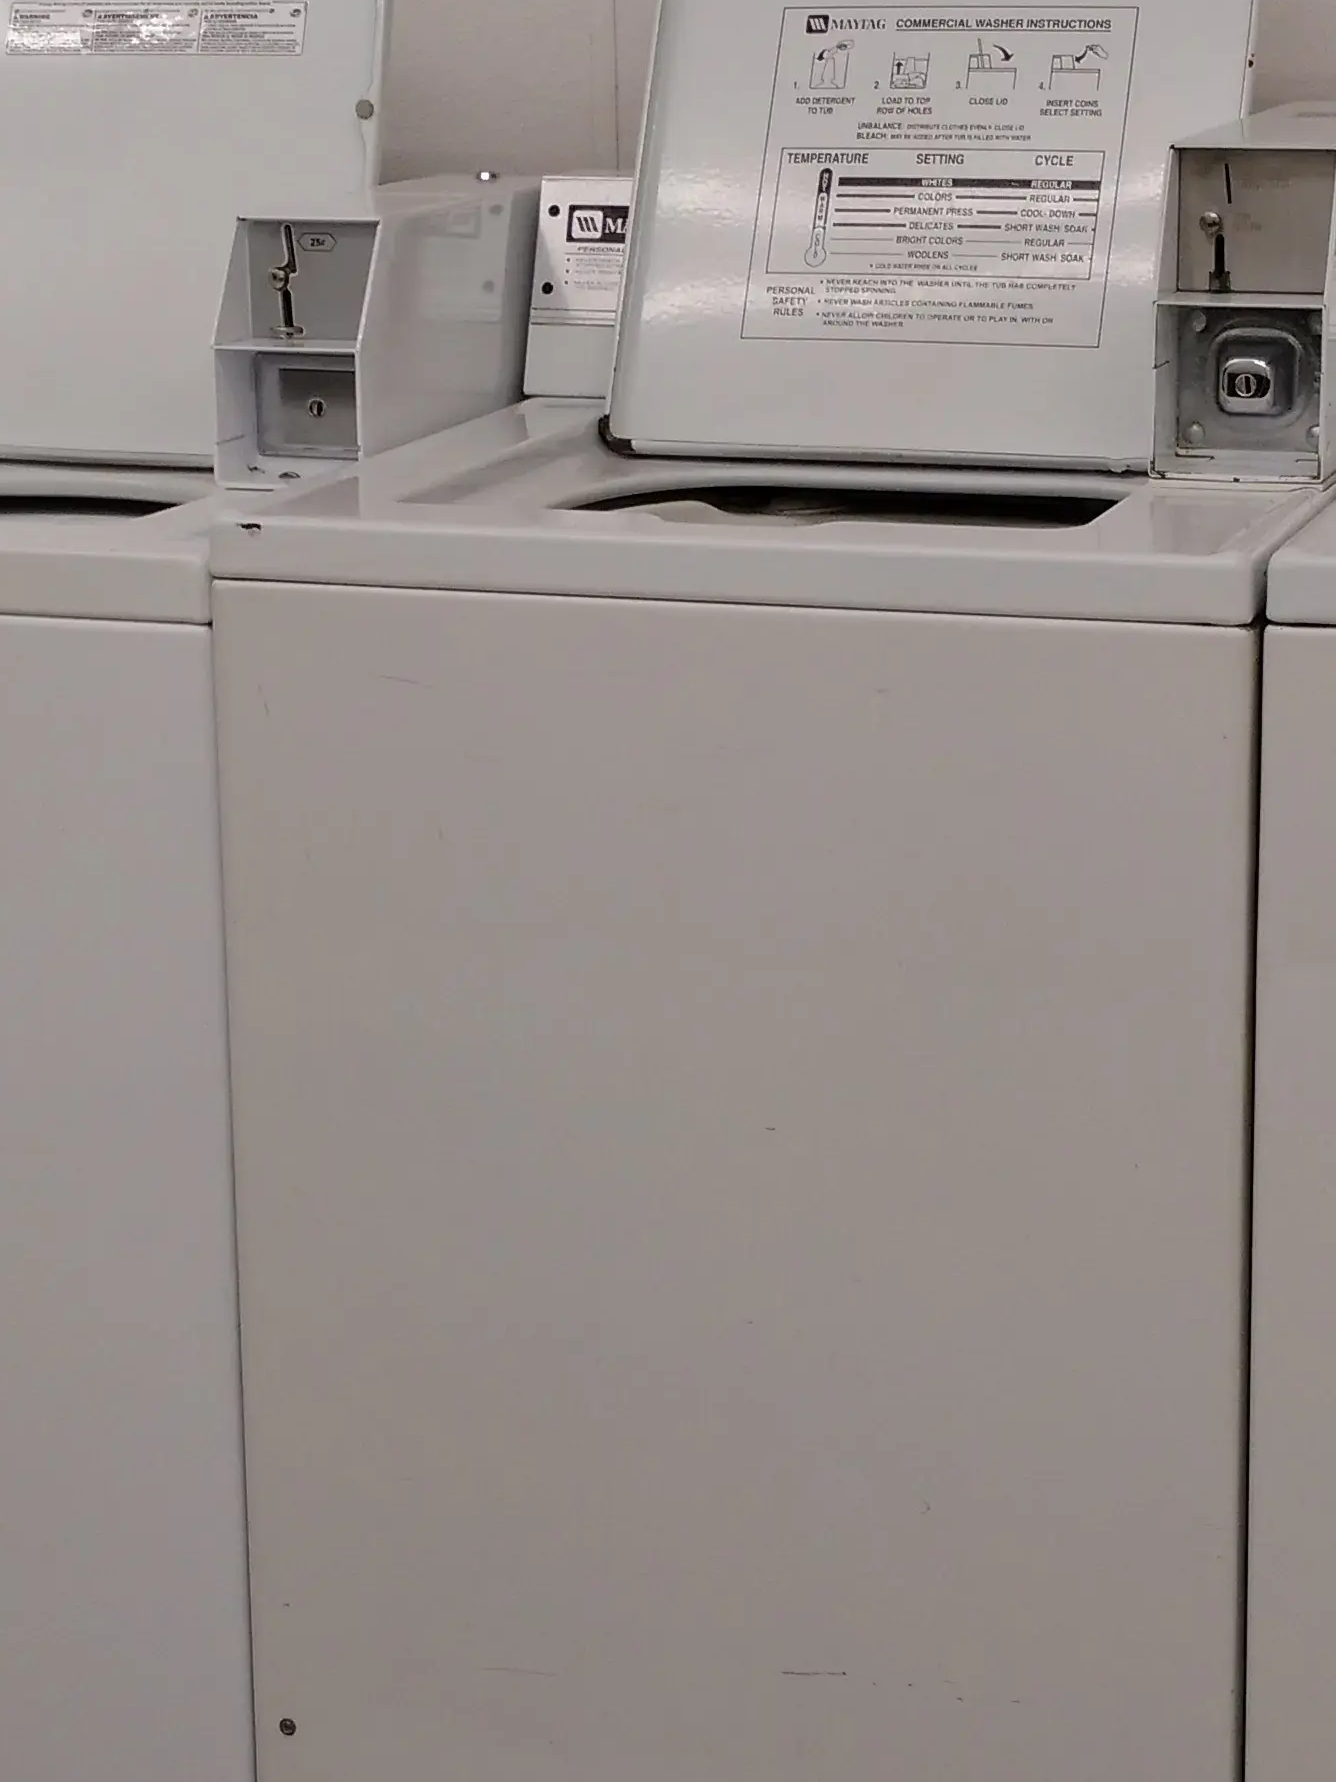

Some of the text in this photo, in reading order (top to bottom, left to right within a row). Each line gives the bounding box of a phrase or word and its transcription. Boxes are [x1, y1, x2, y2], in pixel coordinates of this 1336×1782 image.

[830, 18, 887, 30] MAYTAG
[895, 18, 1112, 30] COMMERCIAL WASHER INSTRUCTIONS
[795, 97, 856, 105] ADD DETERGENT
[881, 97, 931, 105] LOAD TO TOP
[968, 97, 1009, 106] CLOSE LID
[1046, 99, 1099, 108] INSERT COINS
[808, 107, 834, 115] TO TUB
[876, 107, 933, 115] ROW OF HOLES
[1039, 108, 1103, 117] SELECT SETTING
[787, 153, 869, 164] TEMPERATURE
[915, 153, 965, 165] SETTING
[1034, 155, 1074, 166] CYCLE
[921, 178, 953, 187] WHITES
[1030, 180, 1073, 190] REGULAR
[917, 193, 953, 201] COLORS
[1029, 194, 1070, 203] REGULAR
[893, 207, 974, 216] PERMANENT PRESS
[909, 221, 954, 230] DELICATES
[1004, 223, 1088, 233] SHORT WASH SOAK
[895, 236, 964, 245] BRIGHT COLORS
[1024, 238, 1066, 247] REGULAR
[907, 250, 949, 259] WOOLENS
[1001, 253, 1084, 262] SHORT WASH SOAK
[766, 286, 816, 295] PERSONAL
[772, 297, 808, 306] SAFETY
[958, 301, 1005, 309] FLAMMABLE
[773, 308, 804, 317] RULES
